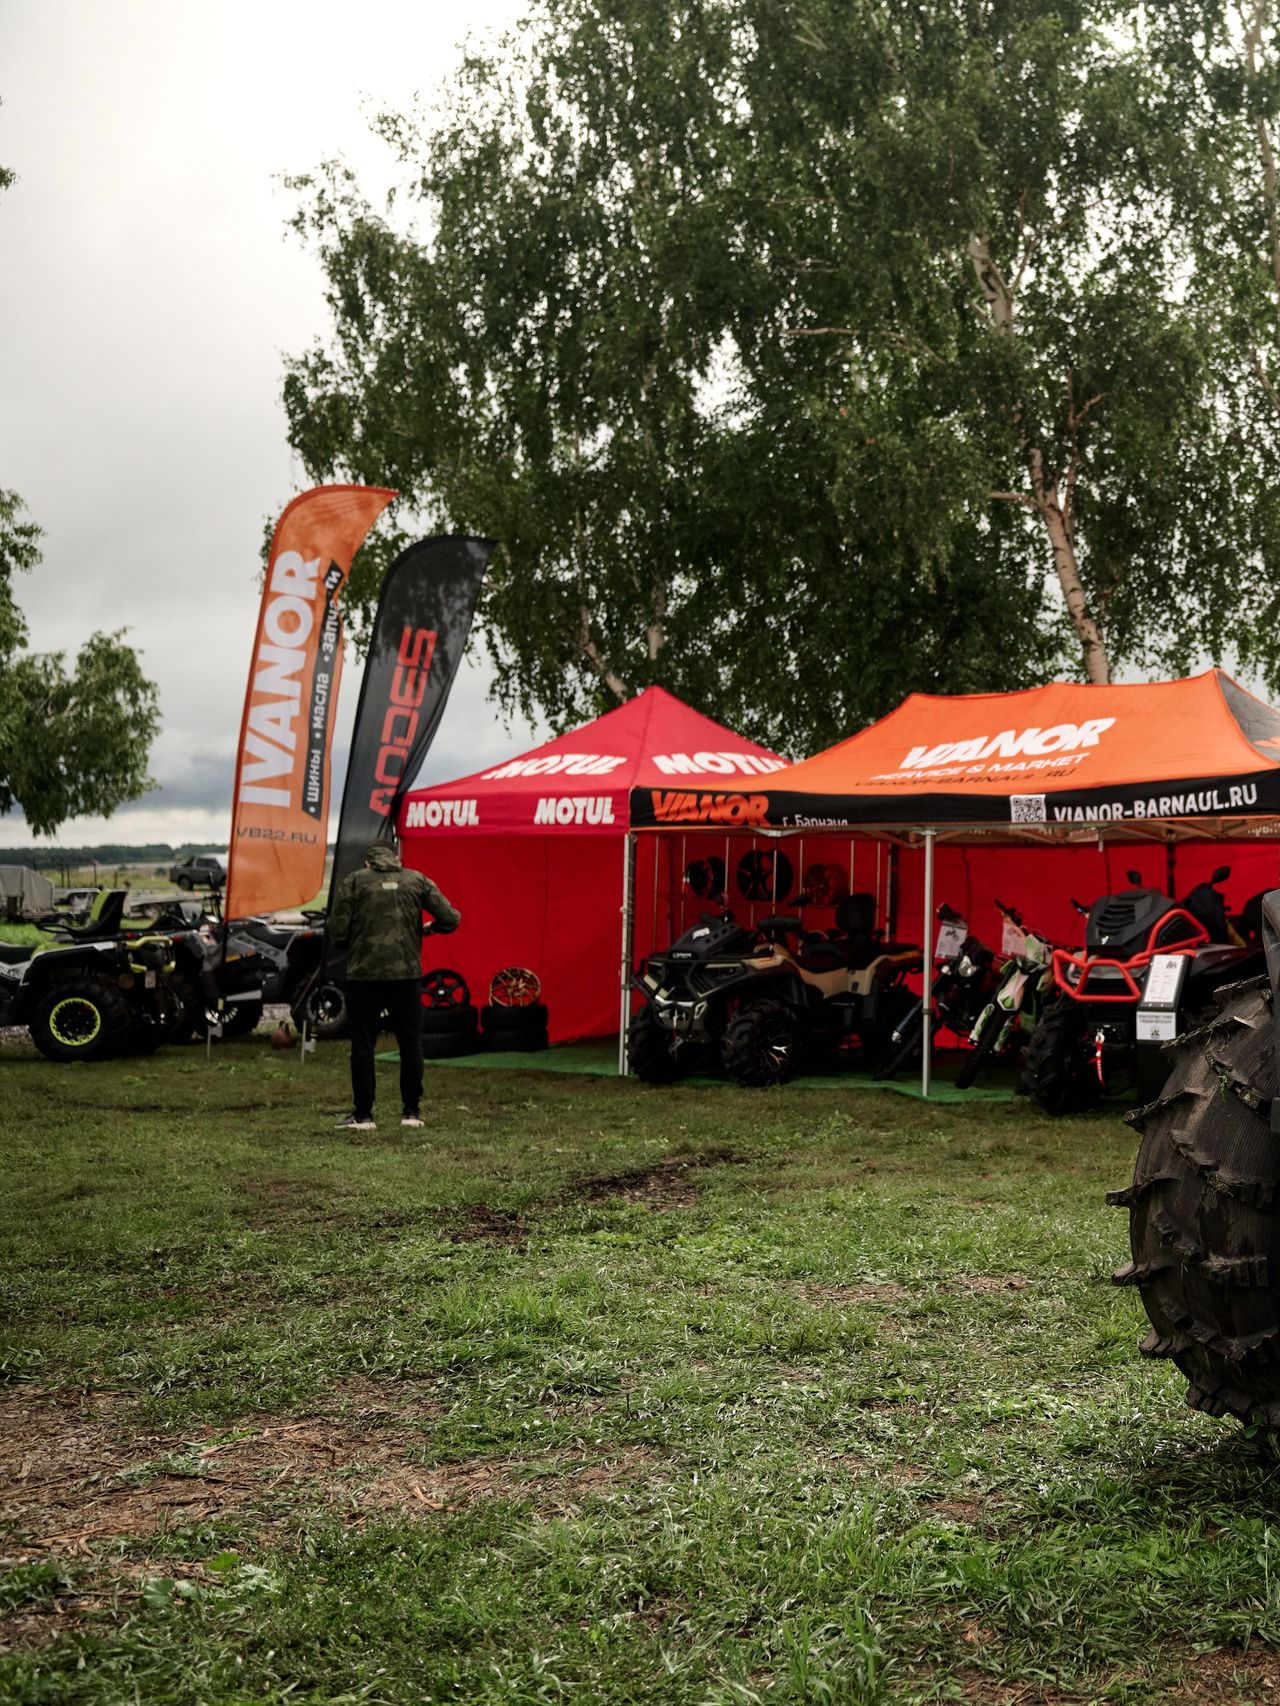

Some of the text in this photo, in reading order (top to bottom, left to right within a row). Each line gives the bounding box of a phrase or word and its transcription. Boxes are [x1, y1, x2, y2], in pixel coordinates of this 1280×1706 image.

[307, 570, 342, 802] шины масла запчати
[480, 754, 628, 780] MOTUL
[870, 753, 1091, 780] SERVICE & MARKET
[405, 799, 480, 828] MOTUL
[534, 797, 615, 825] MOTUL
[651, 790, 771, 827] VIANOR
[1053, 783, 1258, 822] VIANOR-BARNAUL.RU
[236, 826, 318, 844] VB22.RU
